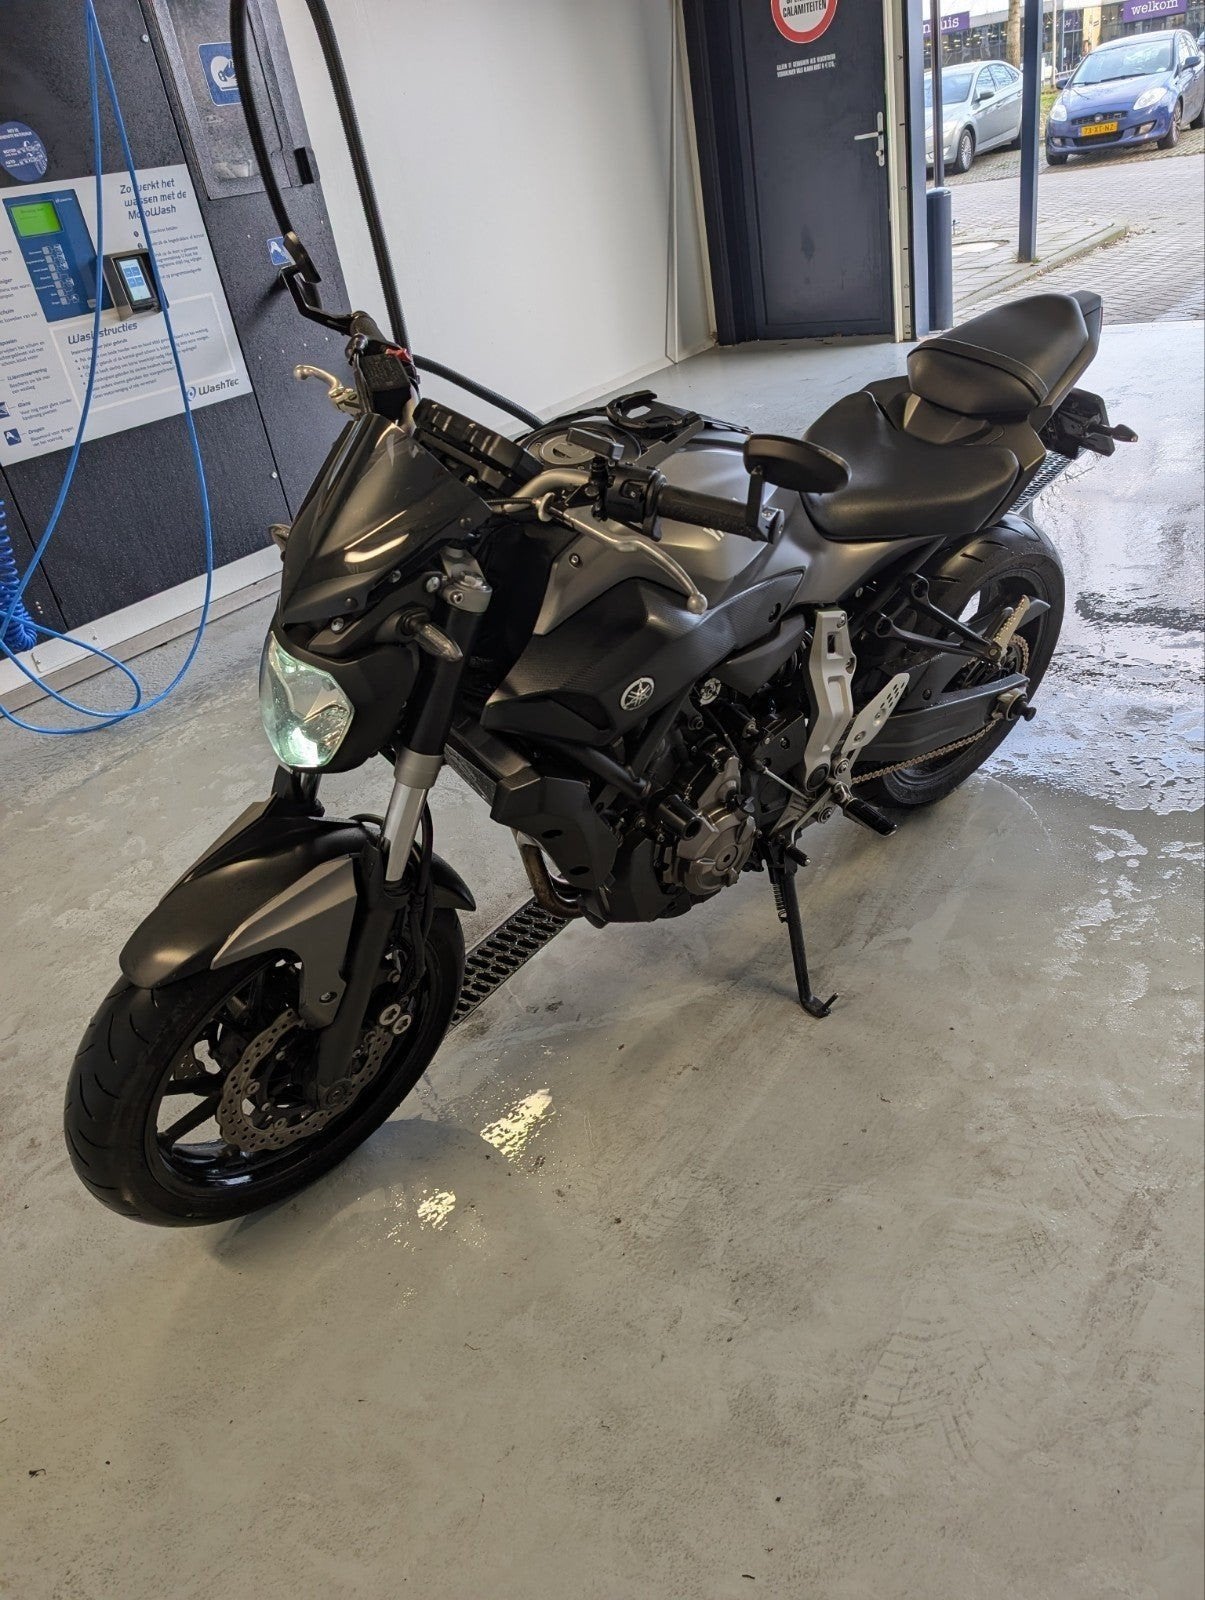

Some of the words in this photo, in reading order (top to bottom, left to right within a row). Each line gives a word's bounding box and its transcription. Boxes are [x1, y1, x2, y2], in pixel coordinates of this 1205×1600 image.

[783, 0, 827, 17] CALAMITEITEN
[1131, 0, 1178, 15] welkom
[120, 184, 132, 194] Zo
[161, 178, 175, 188] het
[160, 192, 175, 202] met
[177, 190, 187, 199] de
[198, 378, 240, 396] WashTec
